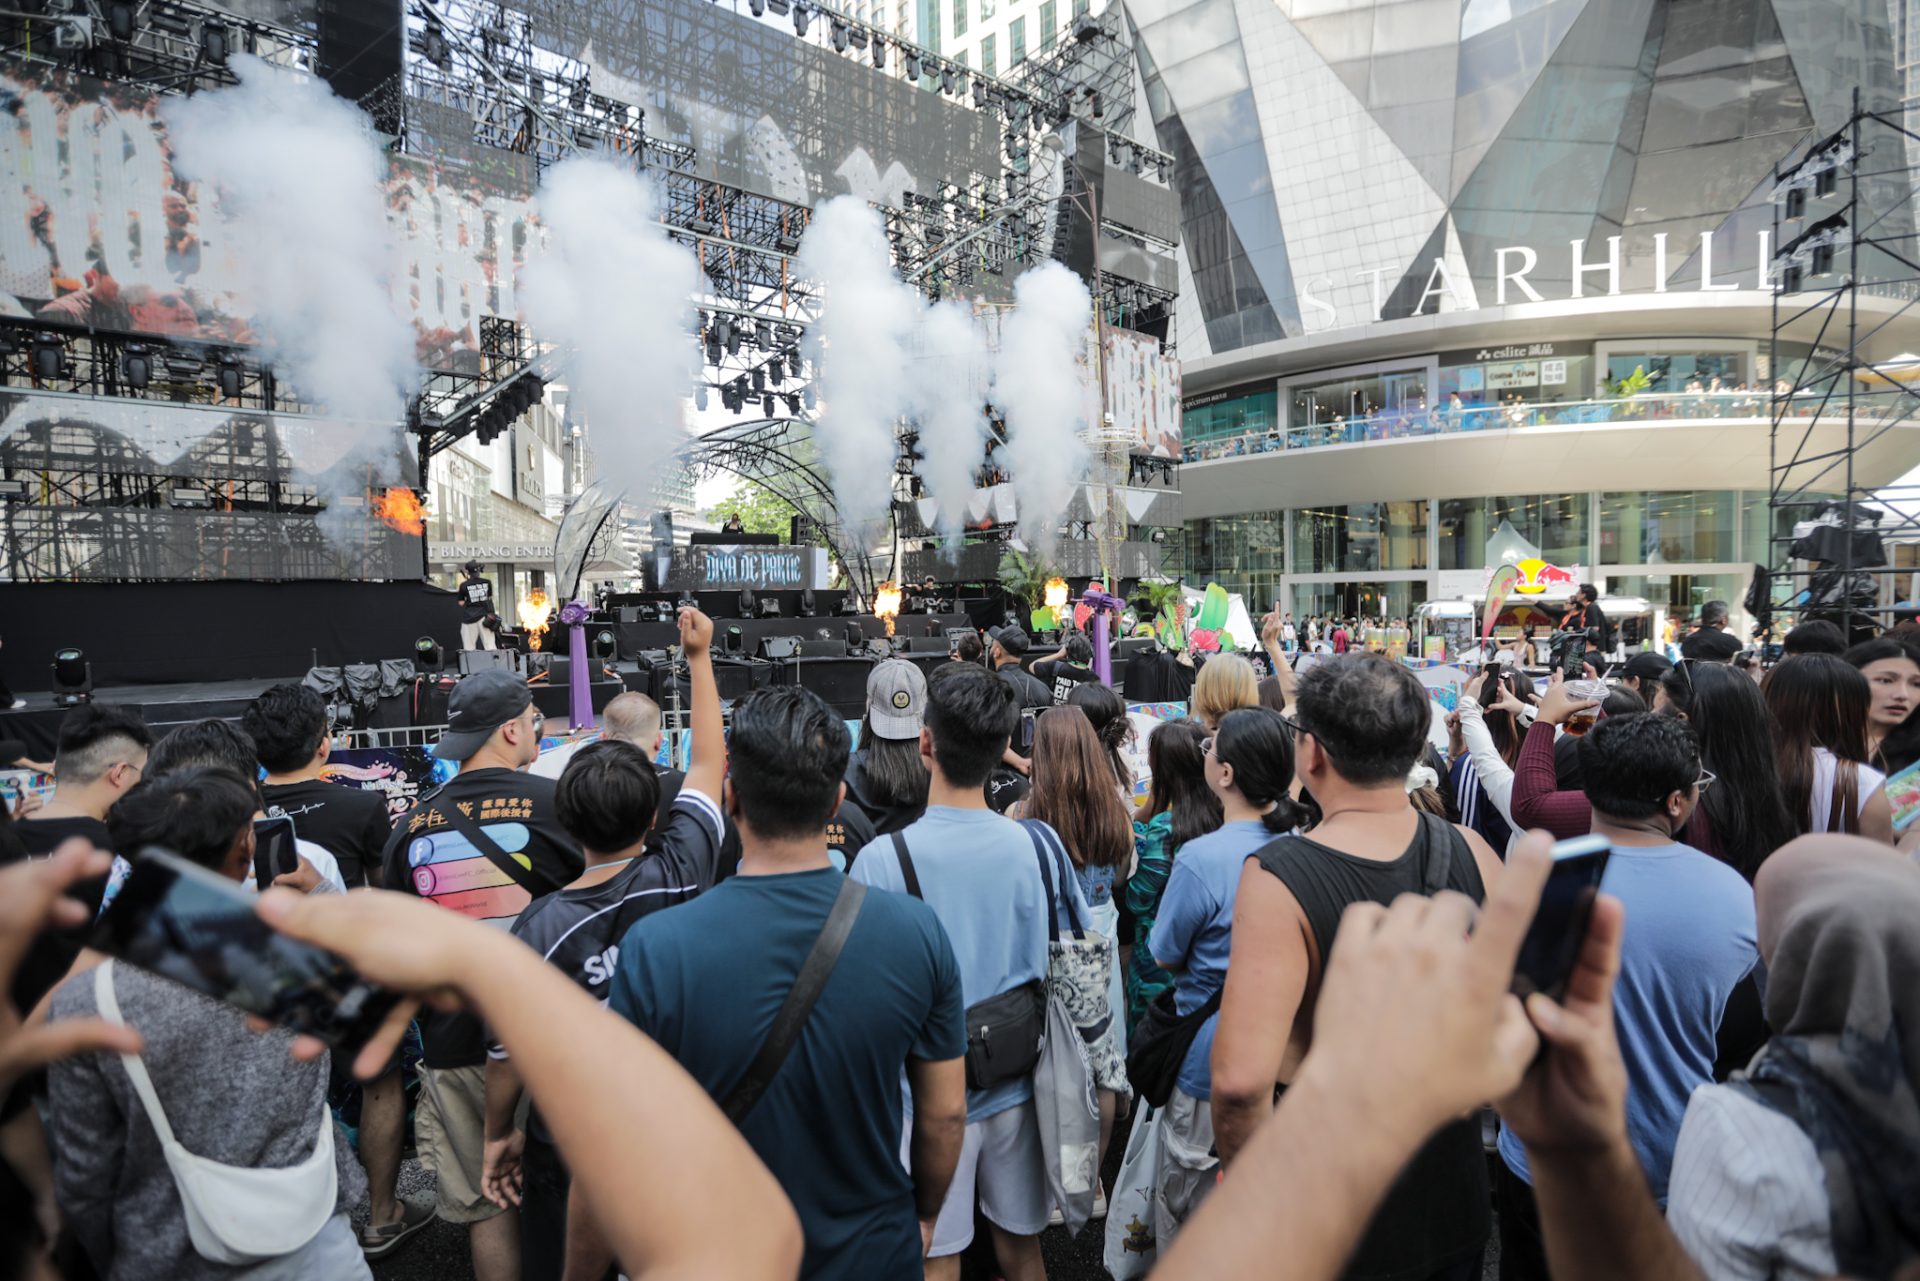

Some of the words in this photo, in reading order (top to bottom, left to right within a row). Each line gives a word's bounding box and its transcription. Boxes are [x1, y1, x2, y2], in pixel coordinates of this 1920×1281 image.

[1493, 347, 1527, 359] eslite
[440, 545, 511, 558] BINTANG
[740, 554, 759, 582] DE
[1056, 676, 1072, 686] PAID
